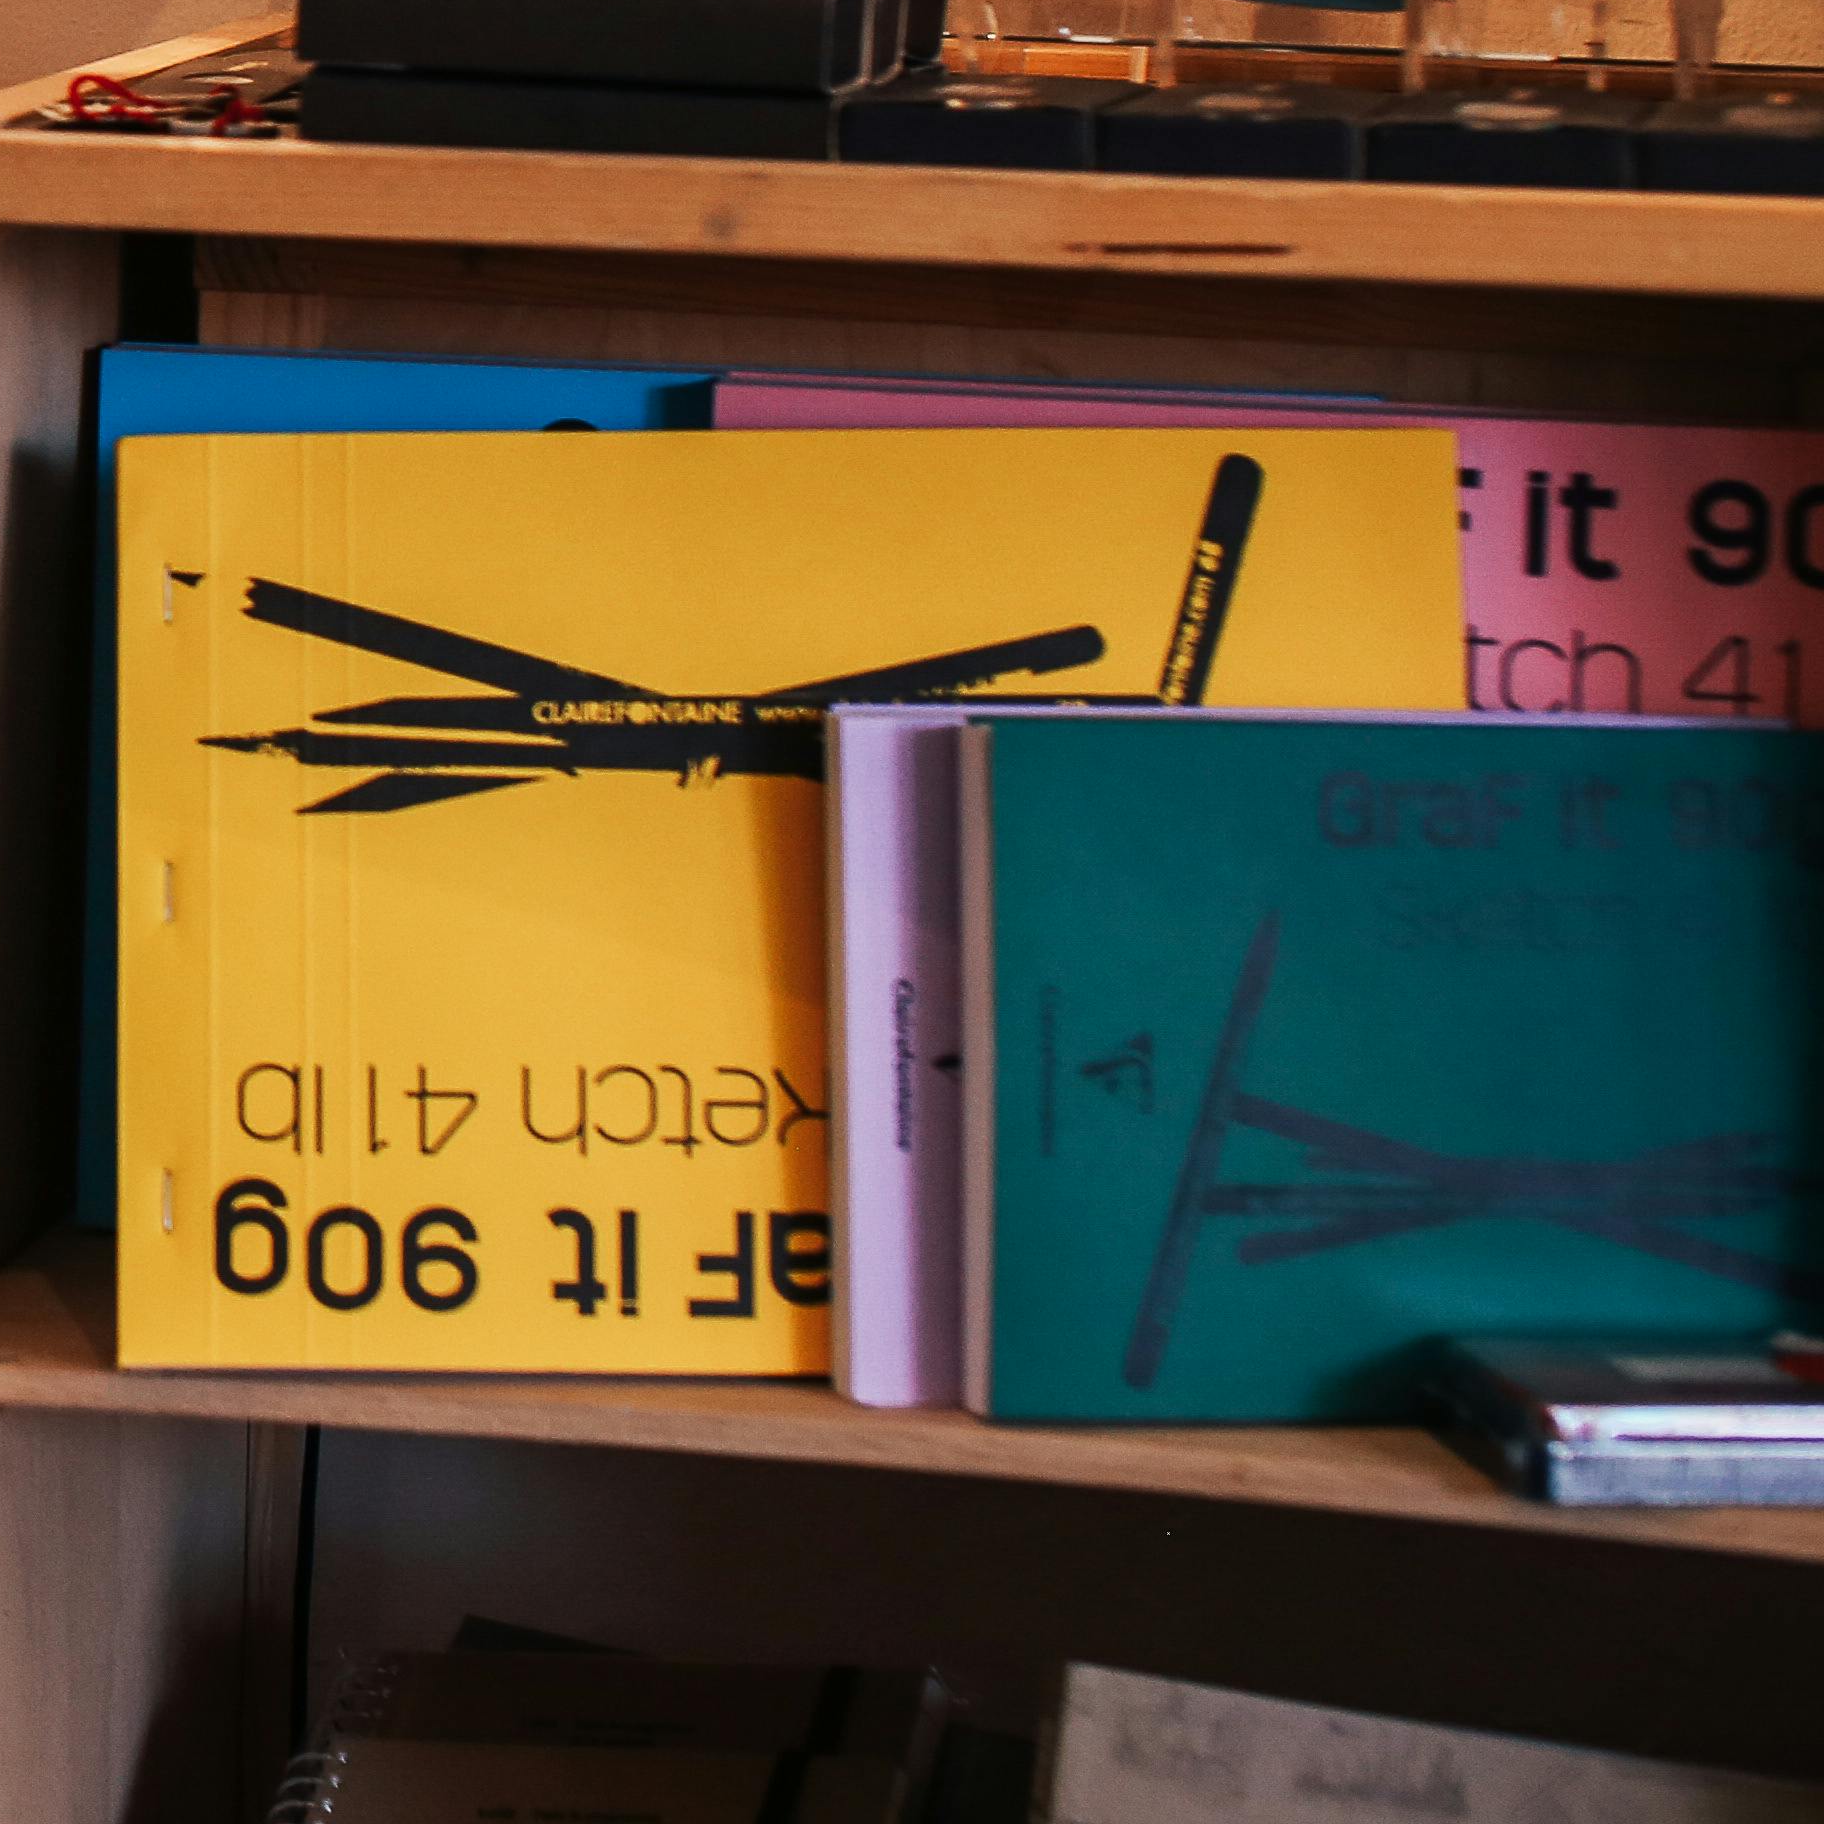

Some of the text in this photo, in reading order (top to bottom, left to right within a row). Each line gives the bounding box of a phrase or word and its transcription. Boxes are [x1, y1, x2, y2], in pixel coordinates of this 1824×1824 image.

[1526, 470, 1620, 580] it
[531, 701, 744, 724] CLAIREFONTAINE
[1465, 624, 1643, 714] tch
[521, 1063, 829, 1157] ketch
[214, 1177, 832, 1319] aF it 90g
